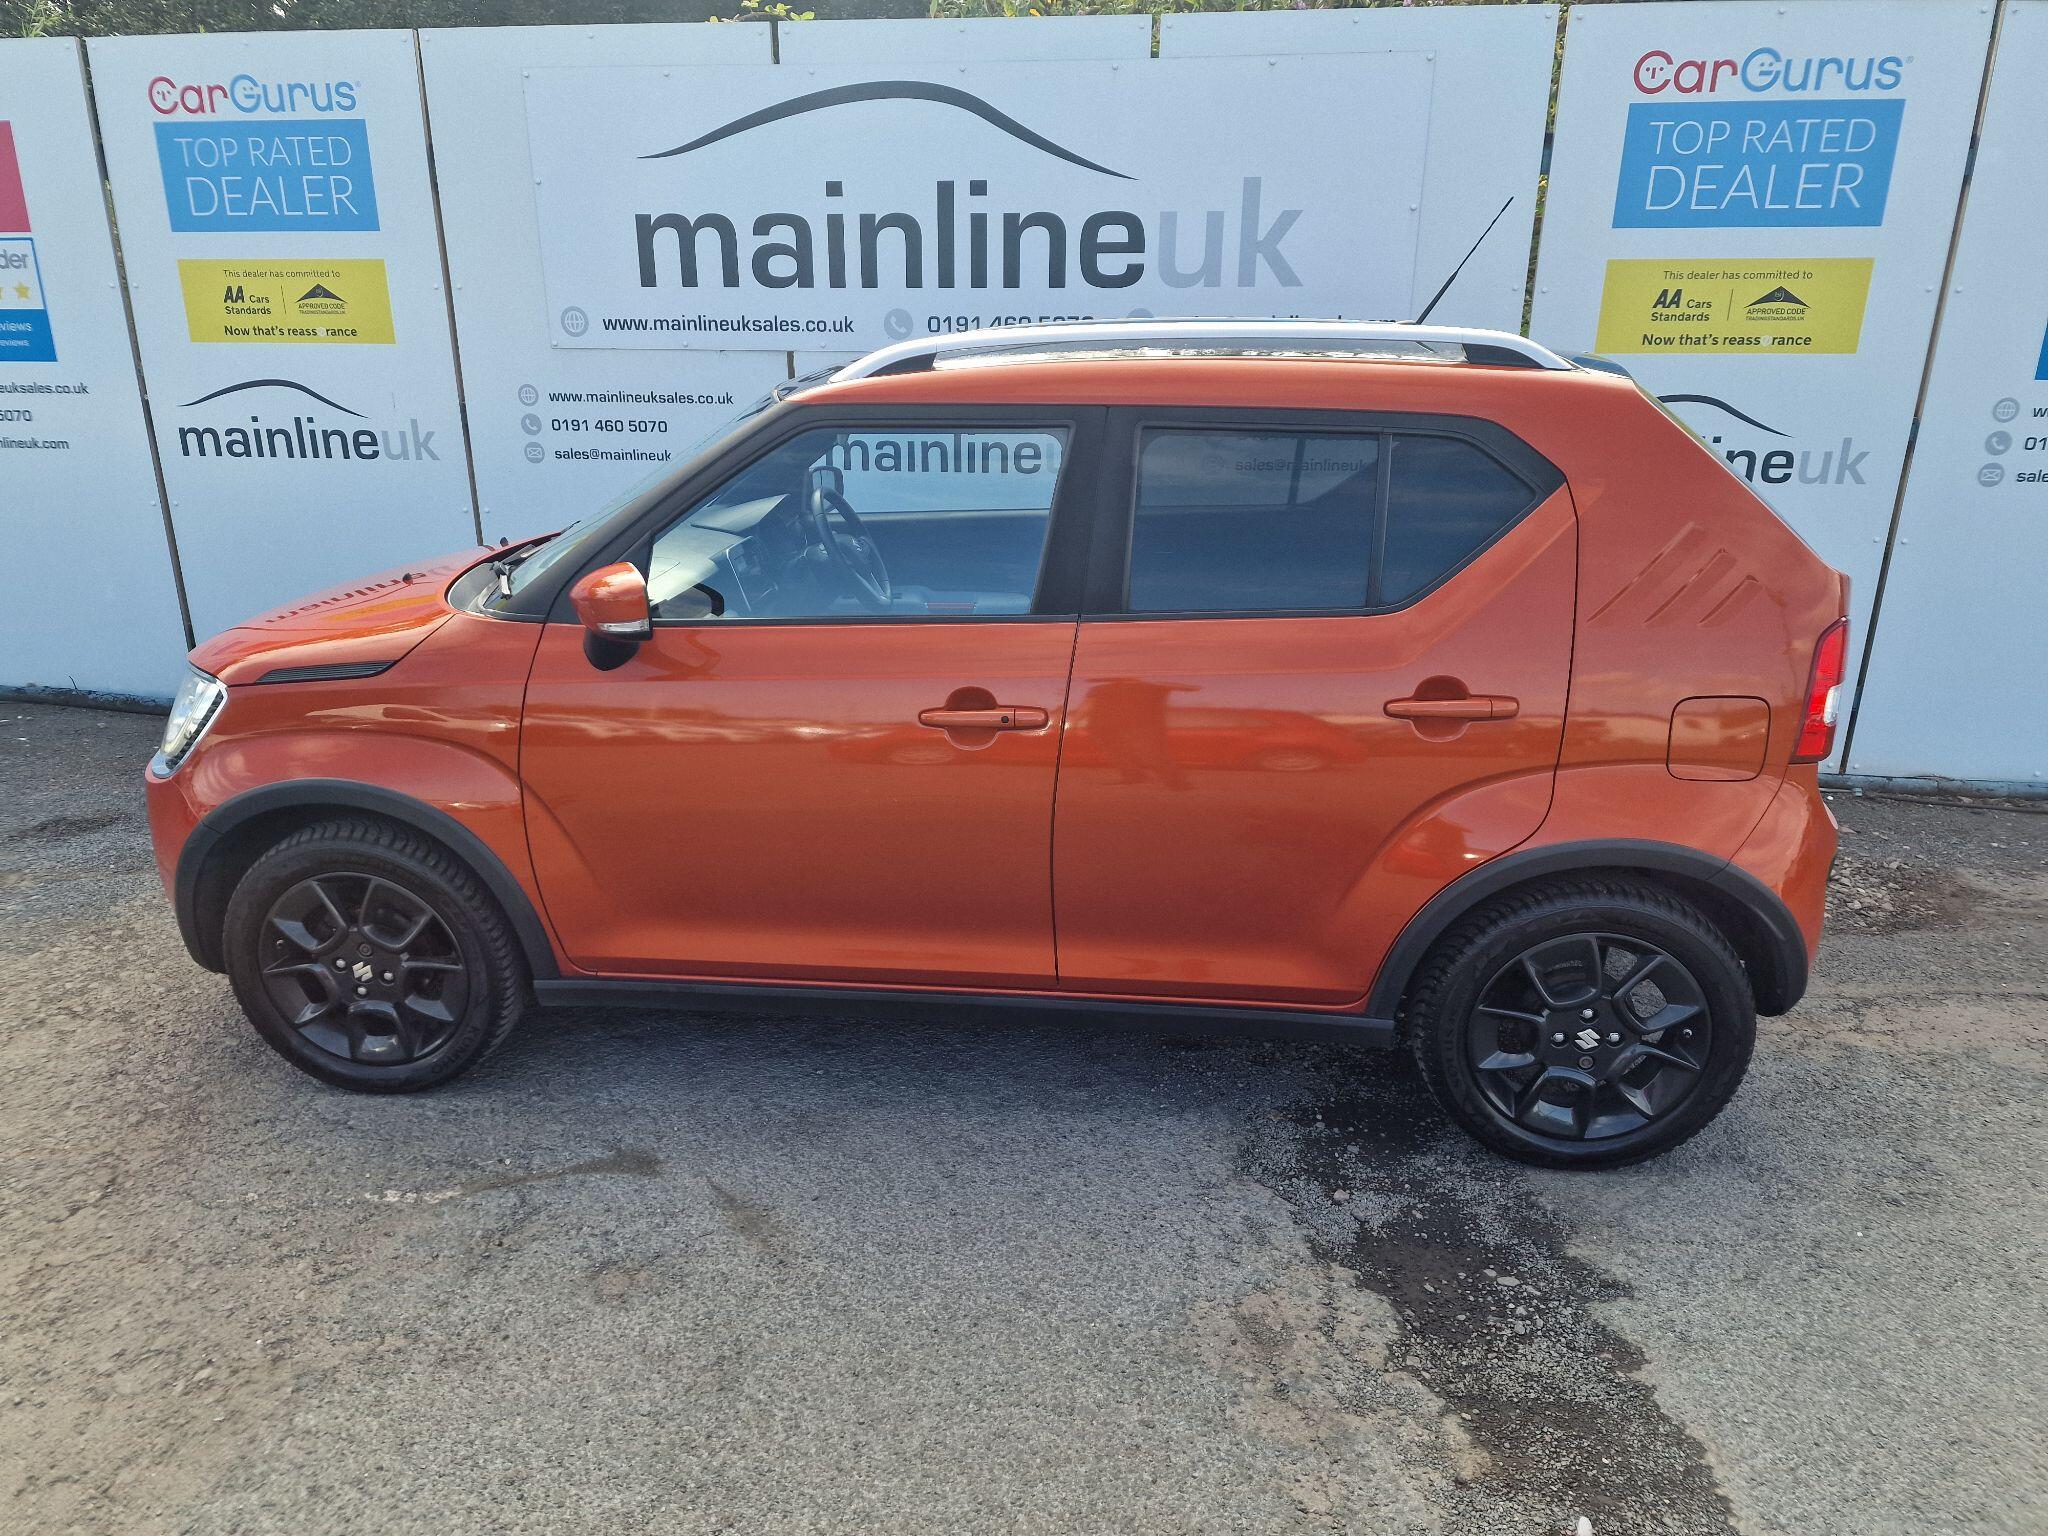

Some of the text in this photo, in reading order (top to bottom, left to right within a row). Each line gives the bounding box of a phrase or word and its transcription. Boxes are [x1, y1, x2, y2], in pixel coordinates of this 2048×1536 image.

[1633, 46, 1903, 95] CarGurus
[147, 74, 357, 115] CarGurus
[1649, 118, 1877, 155] TOP RATED
[173, 136, 352, 168] TOP RATED
[186, 175, 359, 217] DEALER
[1645, 163, 1864, 211] DEALER
[635, 176, 1304, 290] mainlineuk
[223, 269, 341, 278] This dealer has committed to
[1663, 269, 1813, 280] This dealer has committed to
[223, 285, 270, 304] AA Cars
[1652, 288, 1712, 309] AA Cars
[225, 305, 272, 315] Standards
[1650, 311, 1711, 322] Standards
[1746, 307, 1807, 315] APPROVED CODE
[224, 325, 358, 337] Now that's reassrance
[602, 314, 856, 333] www.mainlineuksales.co.uk
[927, 315, 981, 333] 0191
[1642, 333, 1812, 346] Now that's reassrance
[549, 391, 735, 405] www.mainlineuksales.co.uk
[551, 418, 668, 434] 0191 460 5070
[178, 415, 441, 461] mainlineuk
[554, 448, 672, 462] sales@mainlineuk
